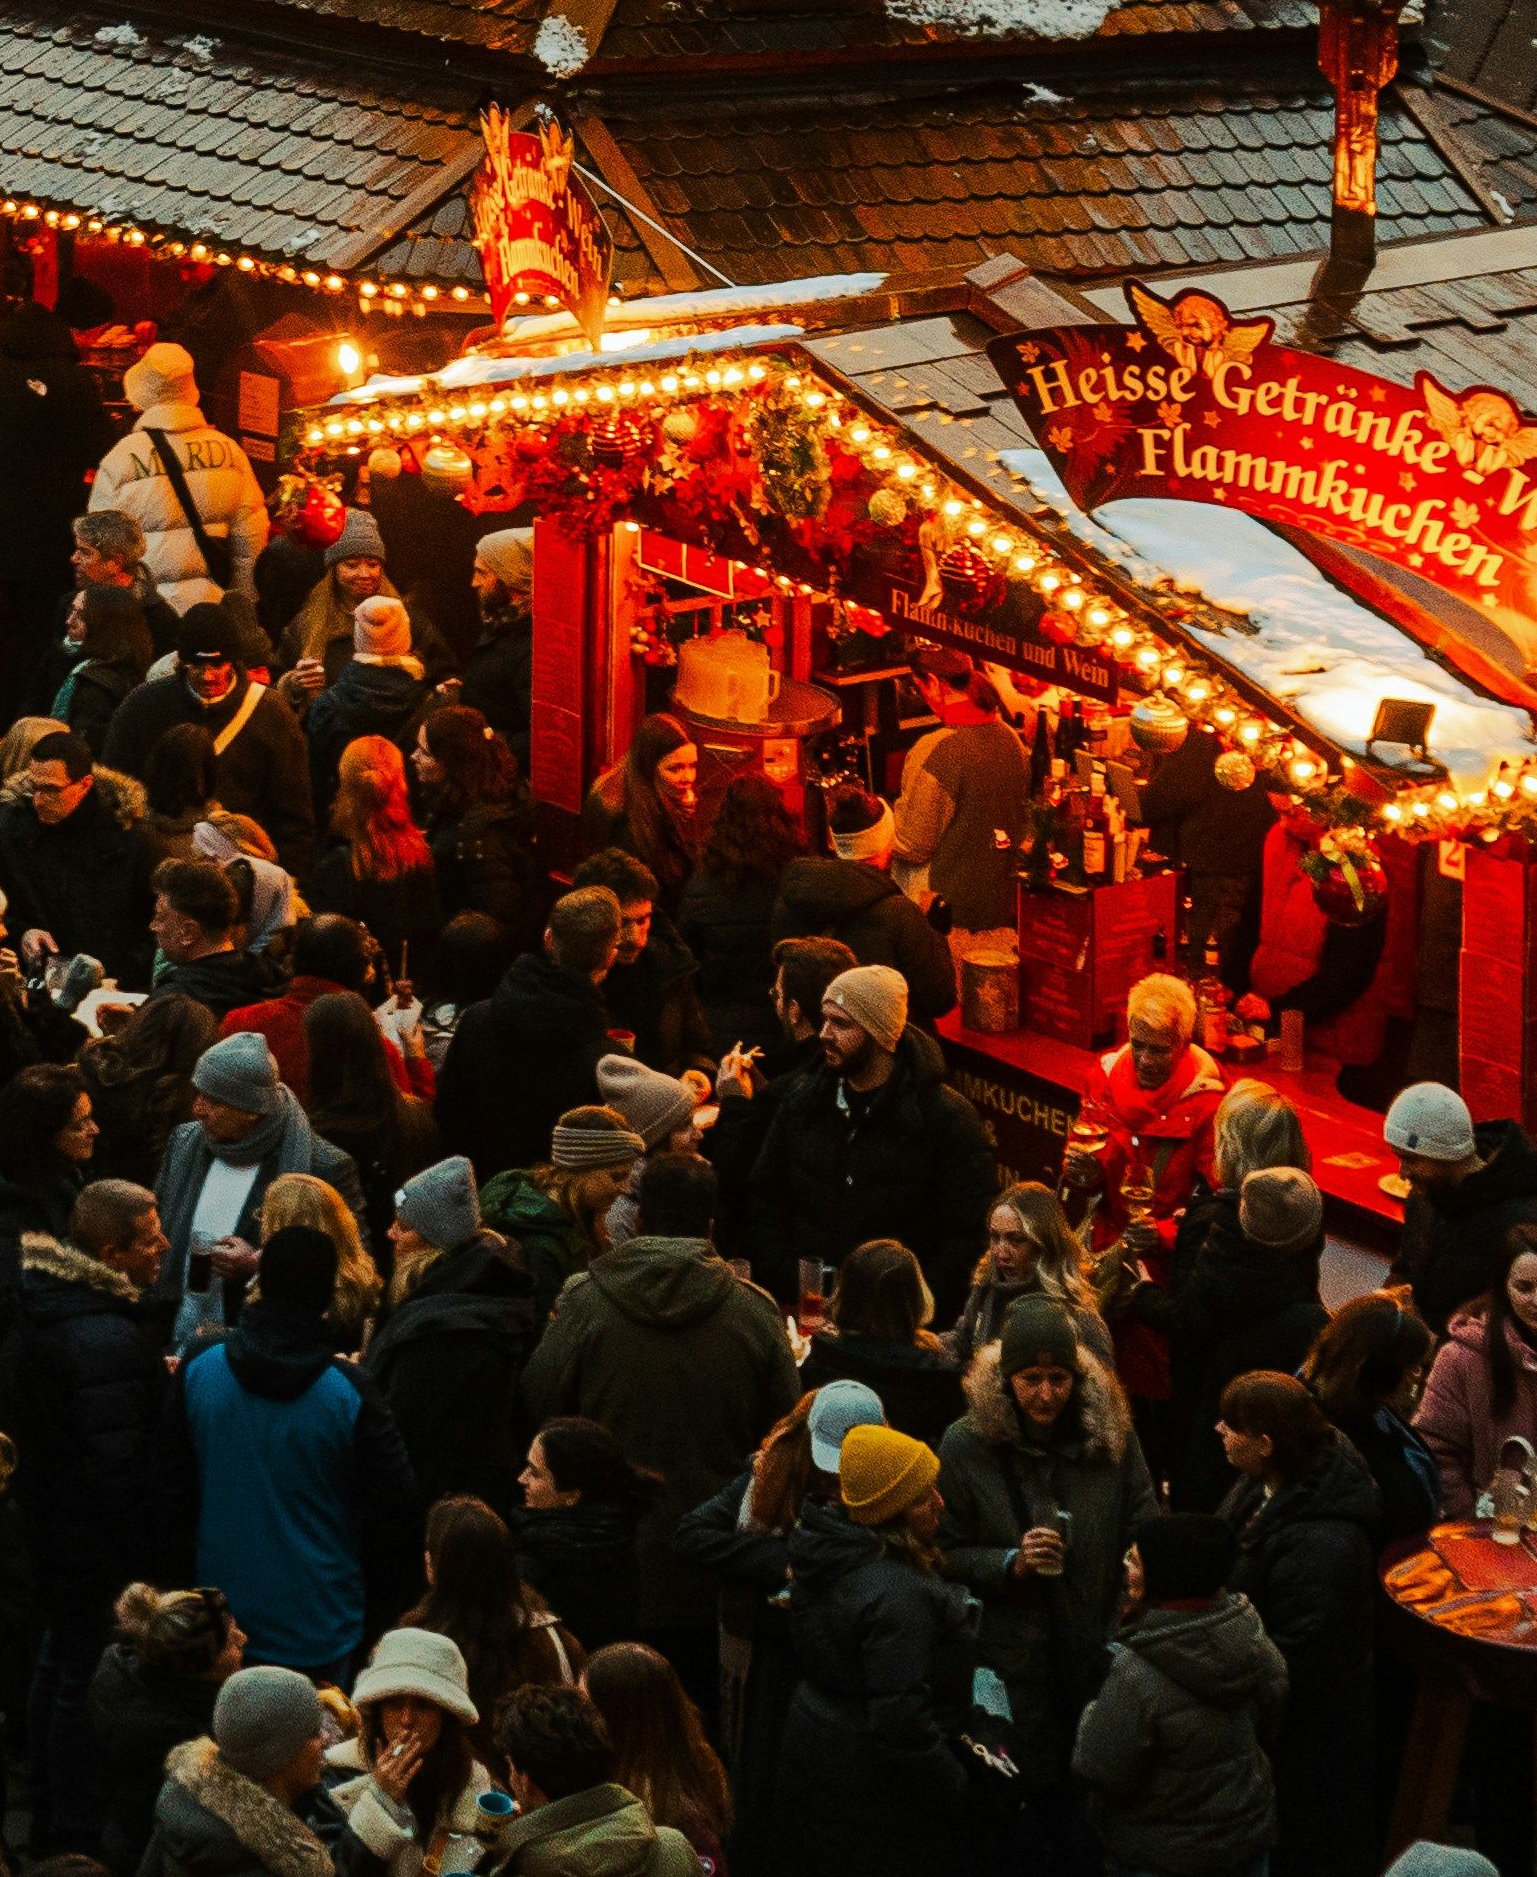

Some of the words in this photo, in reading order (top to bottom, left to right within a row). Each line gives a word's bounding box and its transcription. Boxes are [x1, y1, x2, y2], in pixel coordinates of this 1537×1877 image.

[1027, 352, 1196, 415] Heisse
[1212, 361, 1451, 474] Getränke
[129, 439, 235, 479] MRDI
[1137, 422, 1503, 587] Flammkuchen
[1022, 641, 1056, 669] und
[1062, 647, 1110, 688] Wein
